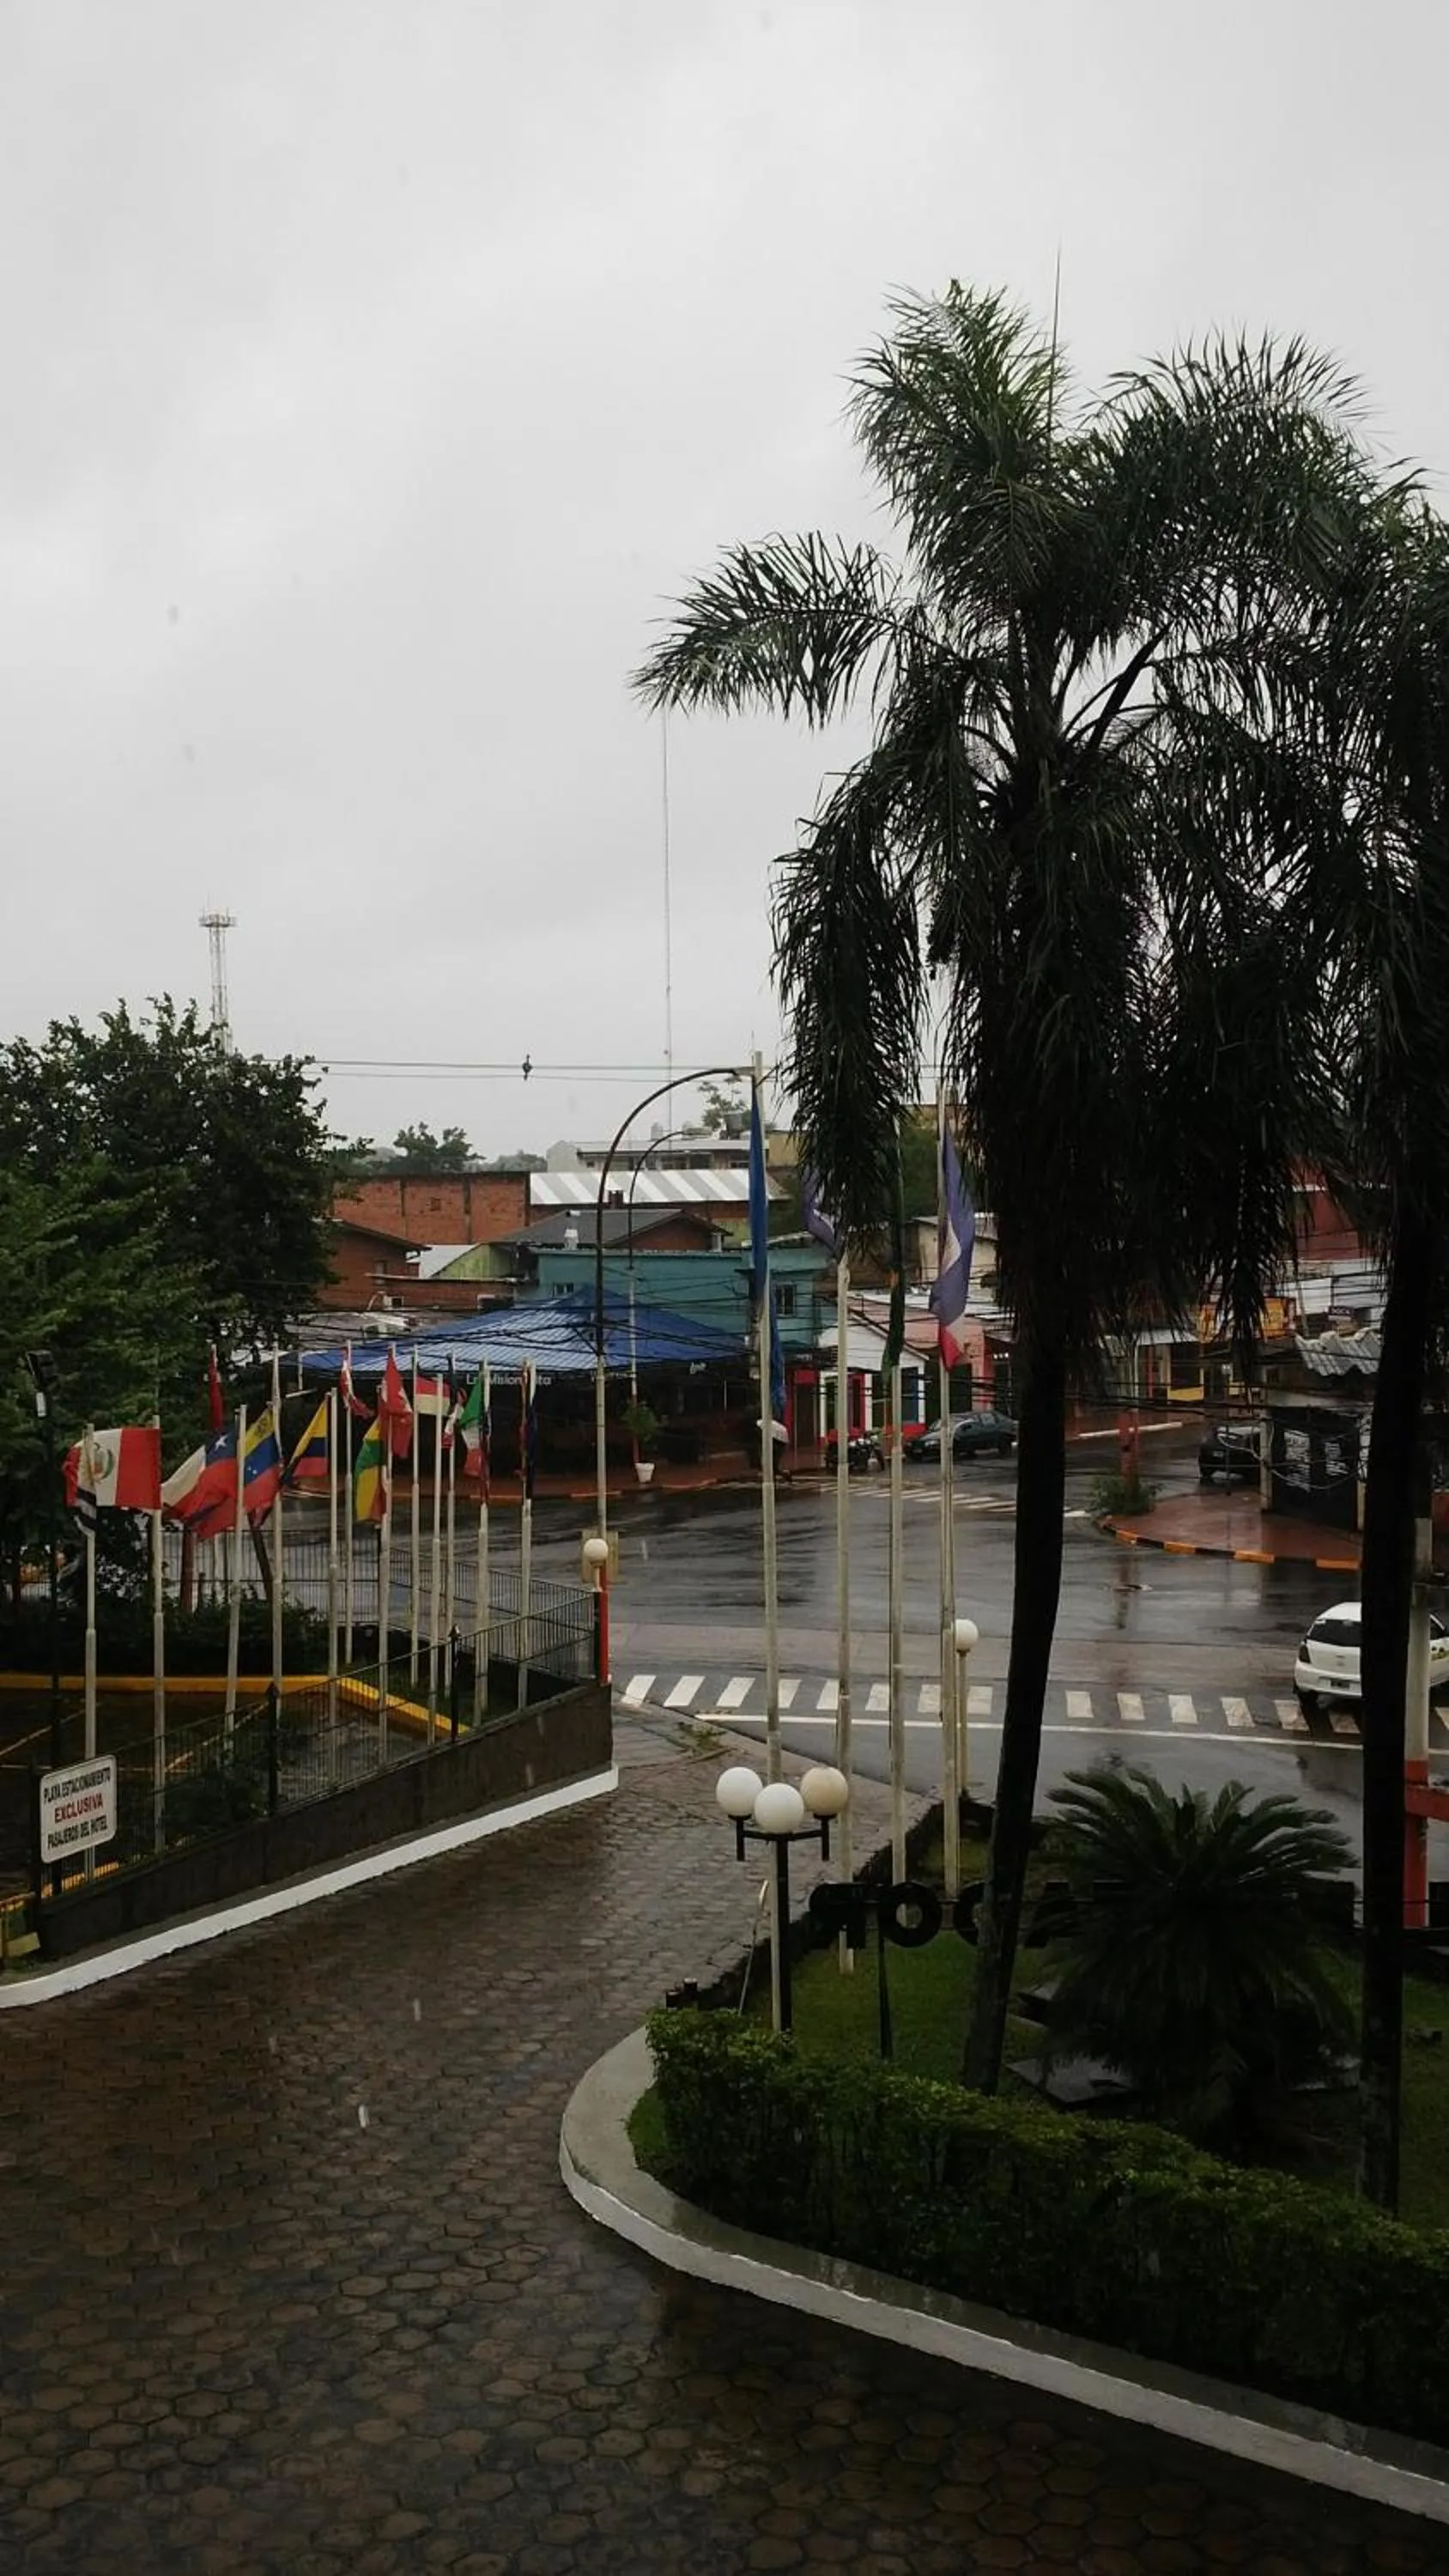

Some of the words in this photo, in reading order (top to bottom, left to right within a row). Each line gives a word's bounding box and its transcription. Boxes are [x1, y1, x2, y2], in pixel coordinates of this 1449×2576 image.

[54, 1792, 104, 1824] EXCLUSIVA
[47, 1824, 78, 1850] PASAJEROS
[80, 1820, 90, 1838] DEL
[91, 1814, 108, 1833] HOTEL
